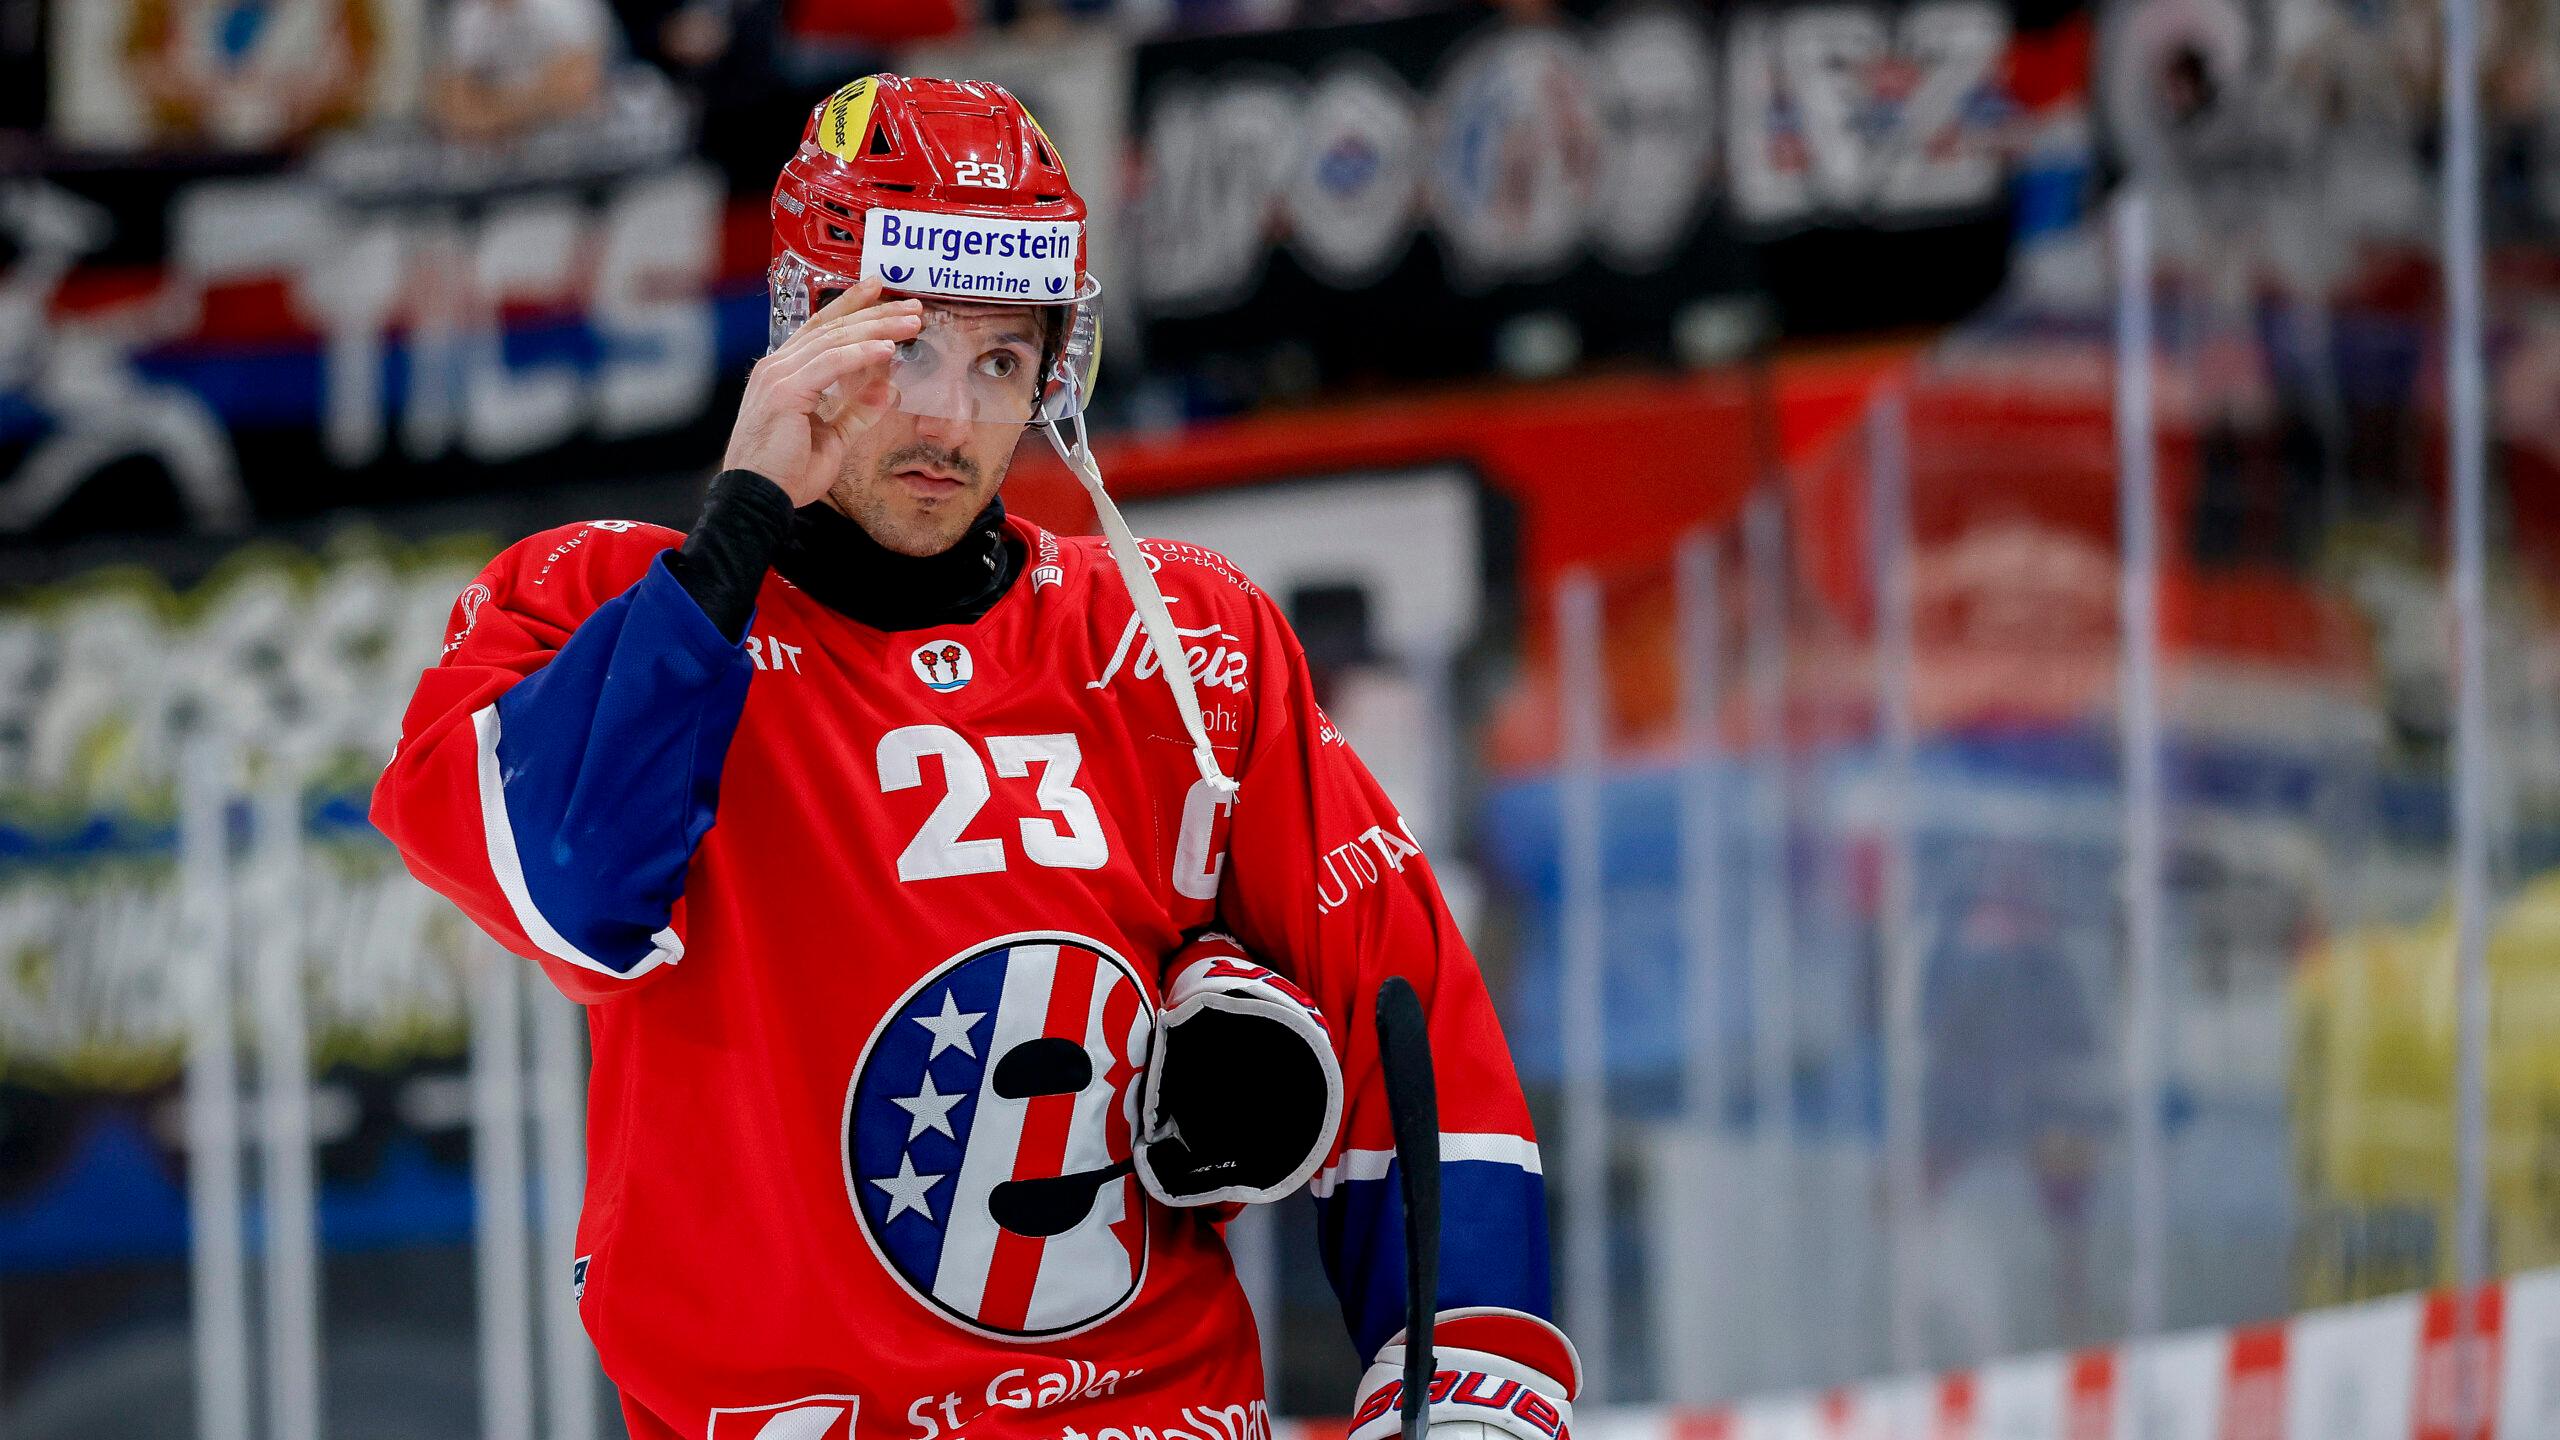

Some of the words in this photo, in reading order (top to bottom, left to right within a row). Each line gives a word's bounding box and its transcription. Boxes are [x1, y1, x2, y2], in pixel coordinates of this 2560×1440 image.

[955, 160, 1007, 189] 23
[881, 214, 1070, 261] Burgerstein
[928, 266, 1031, 294] Vitamine
[876, 724, 1110, 883] 23
[1172, 777, 1233, 900] C
